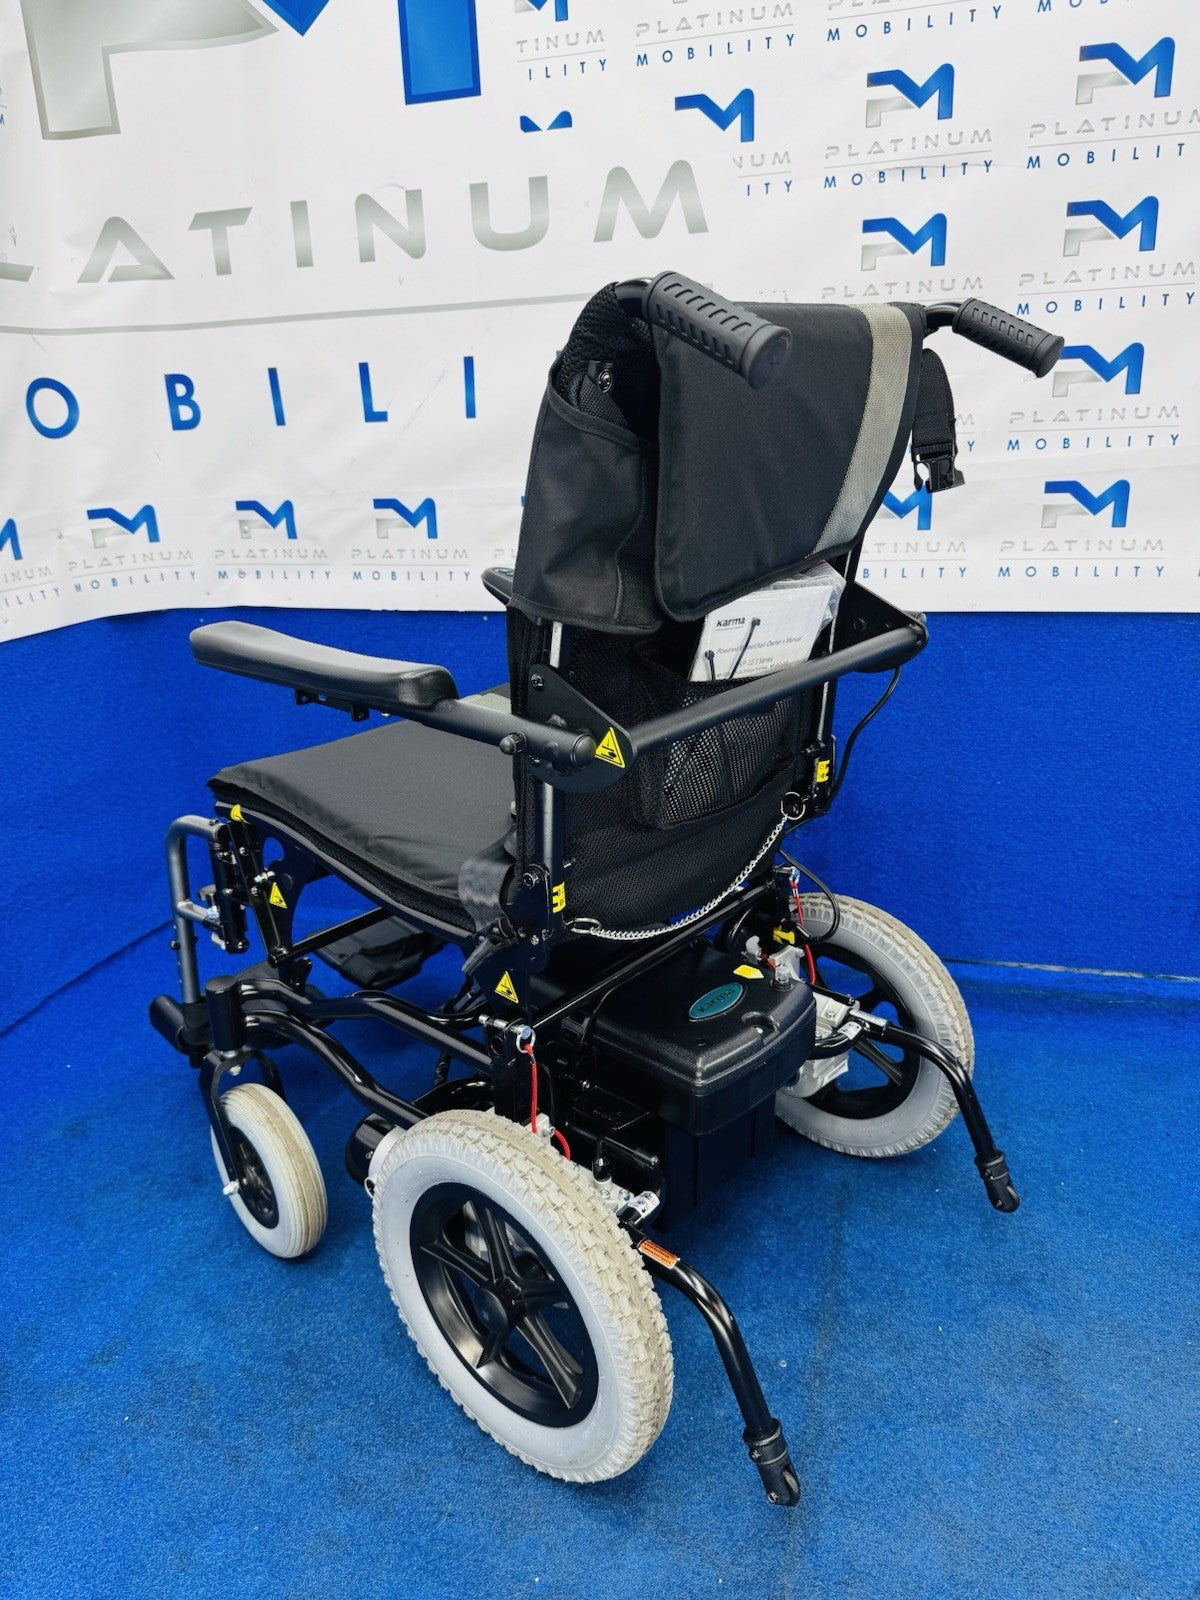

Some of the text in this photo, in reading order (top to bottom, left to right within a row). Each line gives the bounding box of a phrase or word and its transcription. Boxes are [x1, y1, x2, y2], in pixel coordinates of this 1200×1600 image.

[636, 3, 794, 37] PLATINUM
[827, 5, 1002, 42] MOBILITY
[636, 34, 795, 67] MOBILITY
[824, 128, 992, 159] PLATINUM
[824, 160, 993, 188] MOBILITY
[1018, 261, 1197, 287] PLATINUM
[821, 276, 984, 300] PLATINUM
[1016, 291, 1196, 316] MOBILITY
[26, 350, 563, 439] OBILI
[1008, 405, 1180, 424] PLATINUM
[1006, 434, 1179, 451] MOBILITY
[214, 548, 329, 560] PLATINUM
[351, 548, 471, 560] PLATINUM
[999, 538, 1165, 552] PLATINUM
[68, 550, 193, 572] PLATINUM
[75, 571, 197, 592] MOBILITY
[217, 569, 332, 581] MOBILITY
[352, 570, 472, 581] MOBILITY
[862, 566, 968, 579] BILITY
[997, 566, 1165, 578] MOBILITY
